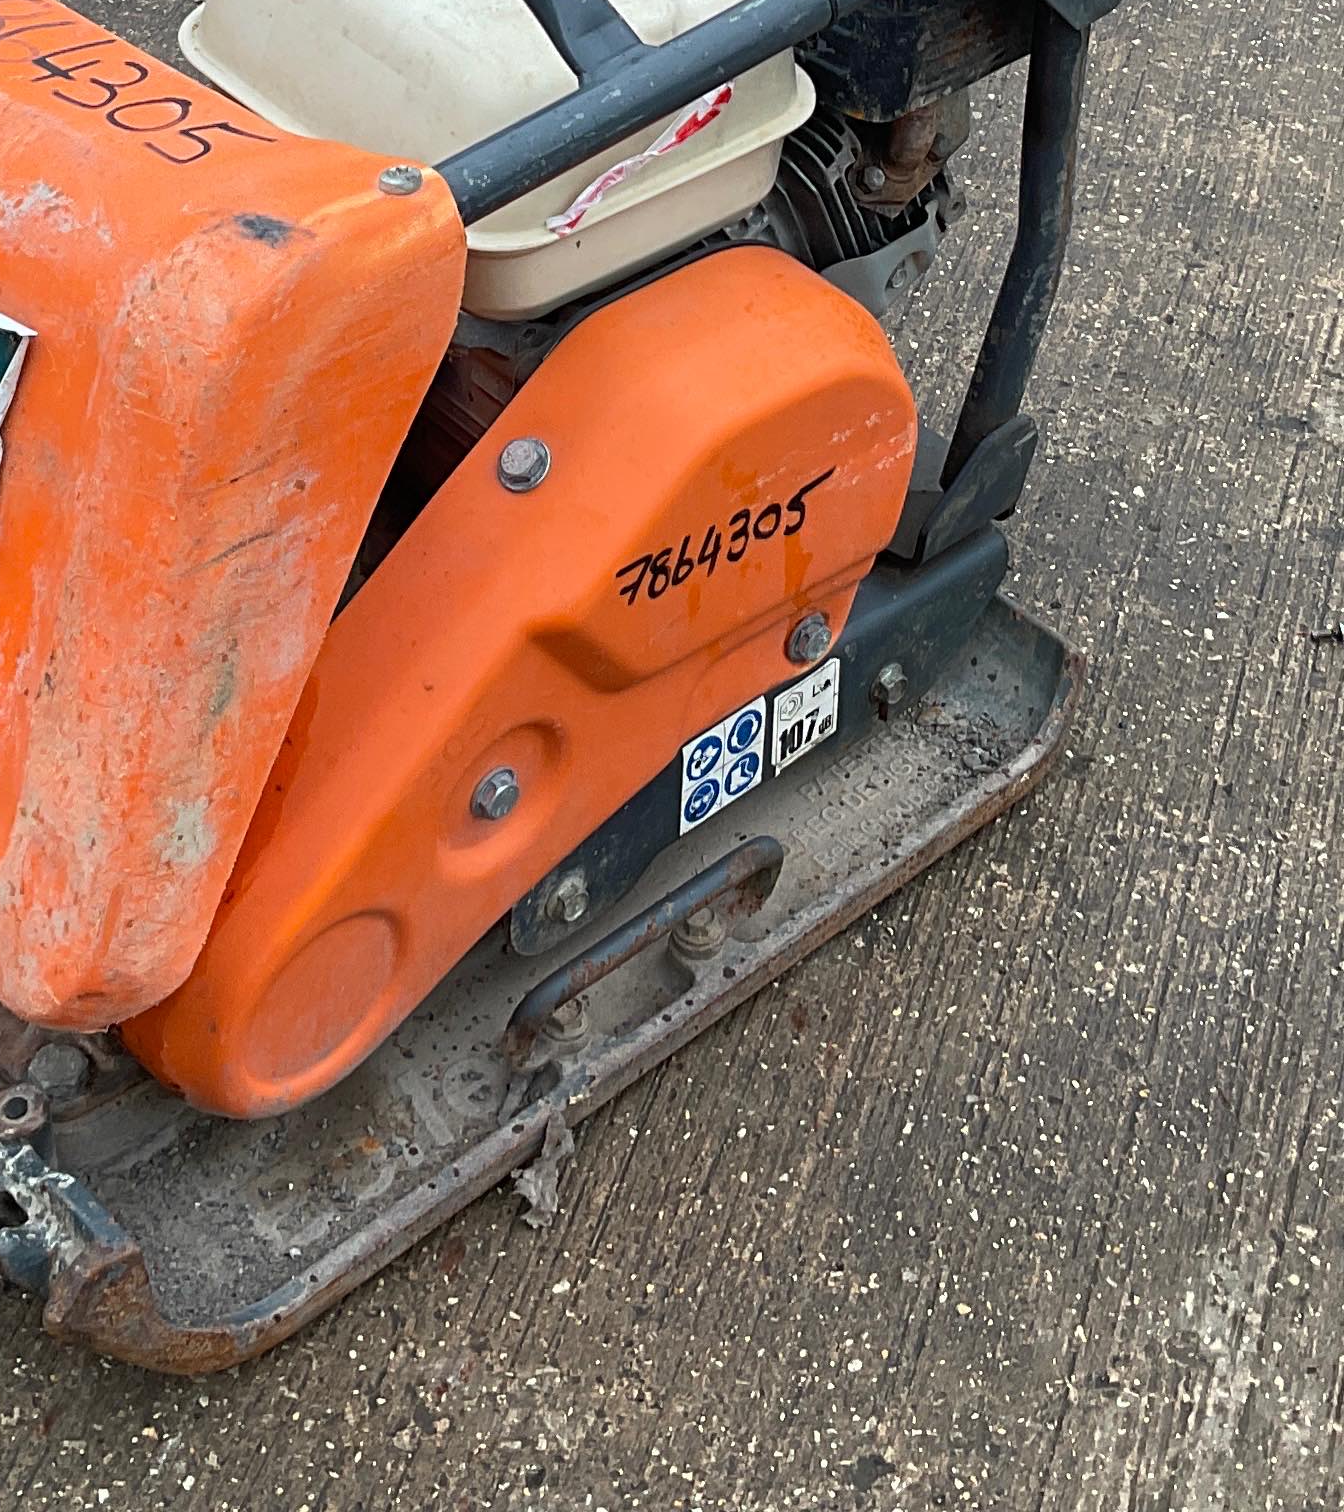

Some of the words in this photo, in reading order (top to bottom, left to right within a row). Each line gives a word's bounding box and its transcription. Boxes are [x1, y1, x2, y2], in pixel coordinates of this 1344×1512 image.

[615, 465, 837, 607] 7864305
[779, 707, 820, 762] 107
[818, 714, 832, 735] dB
